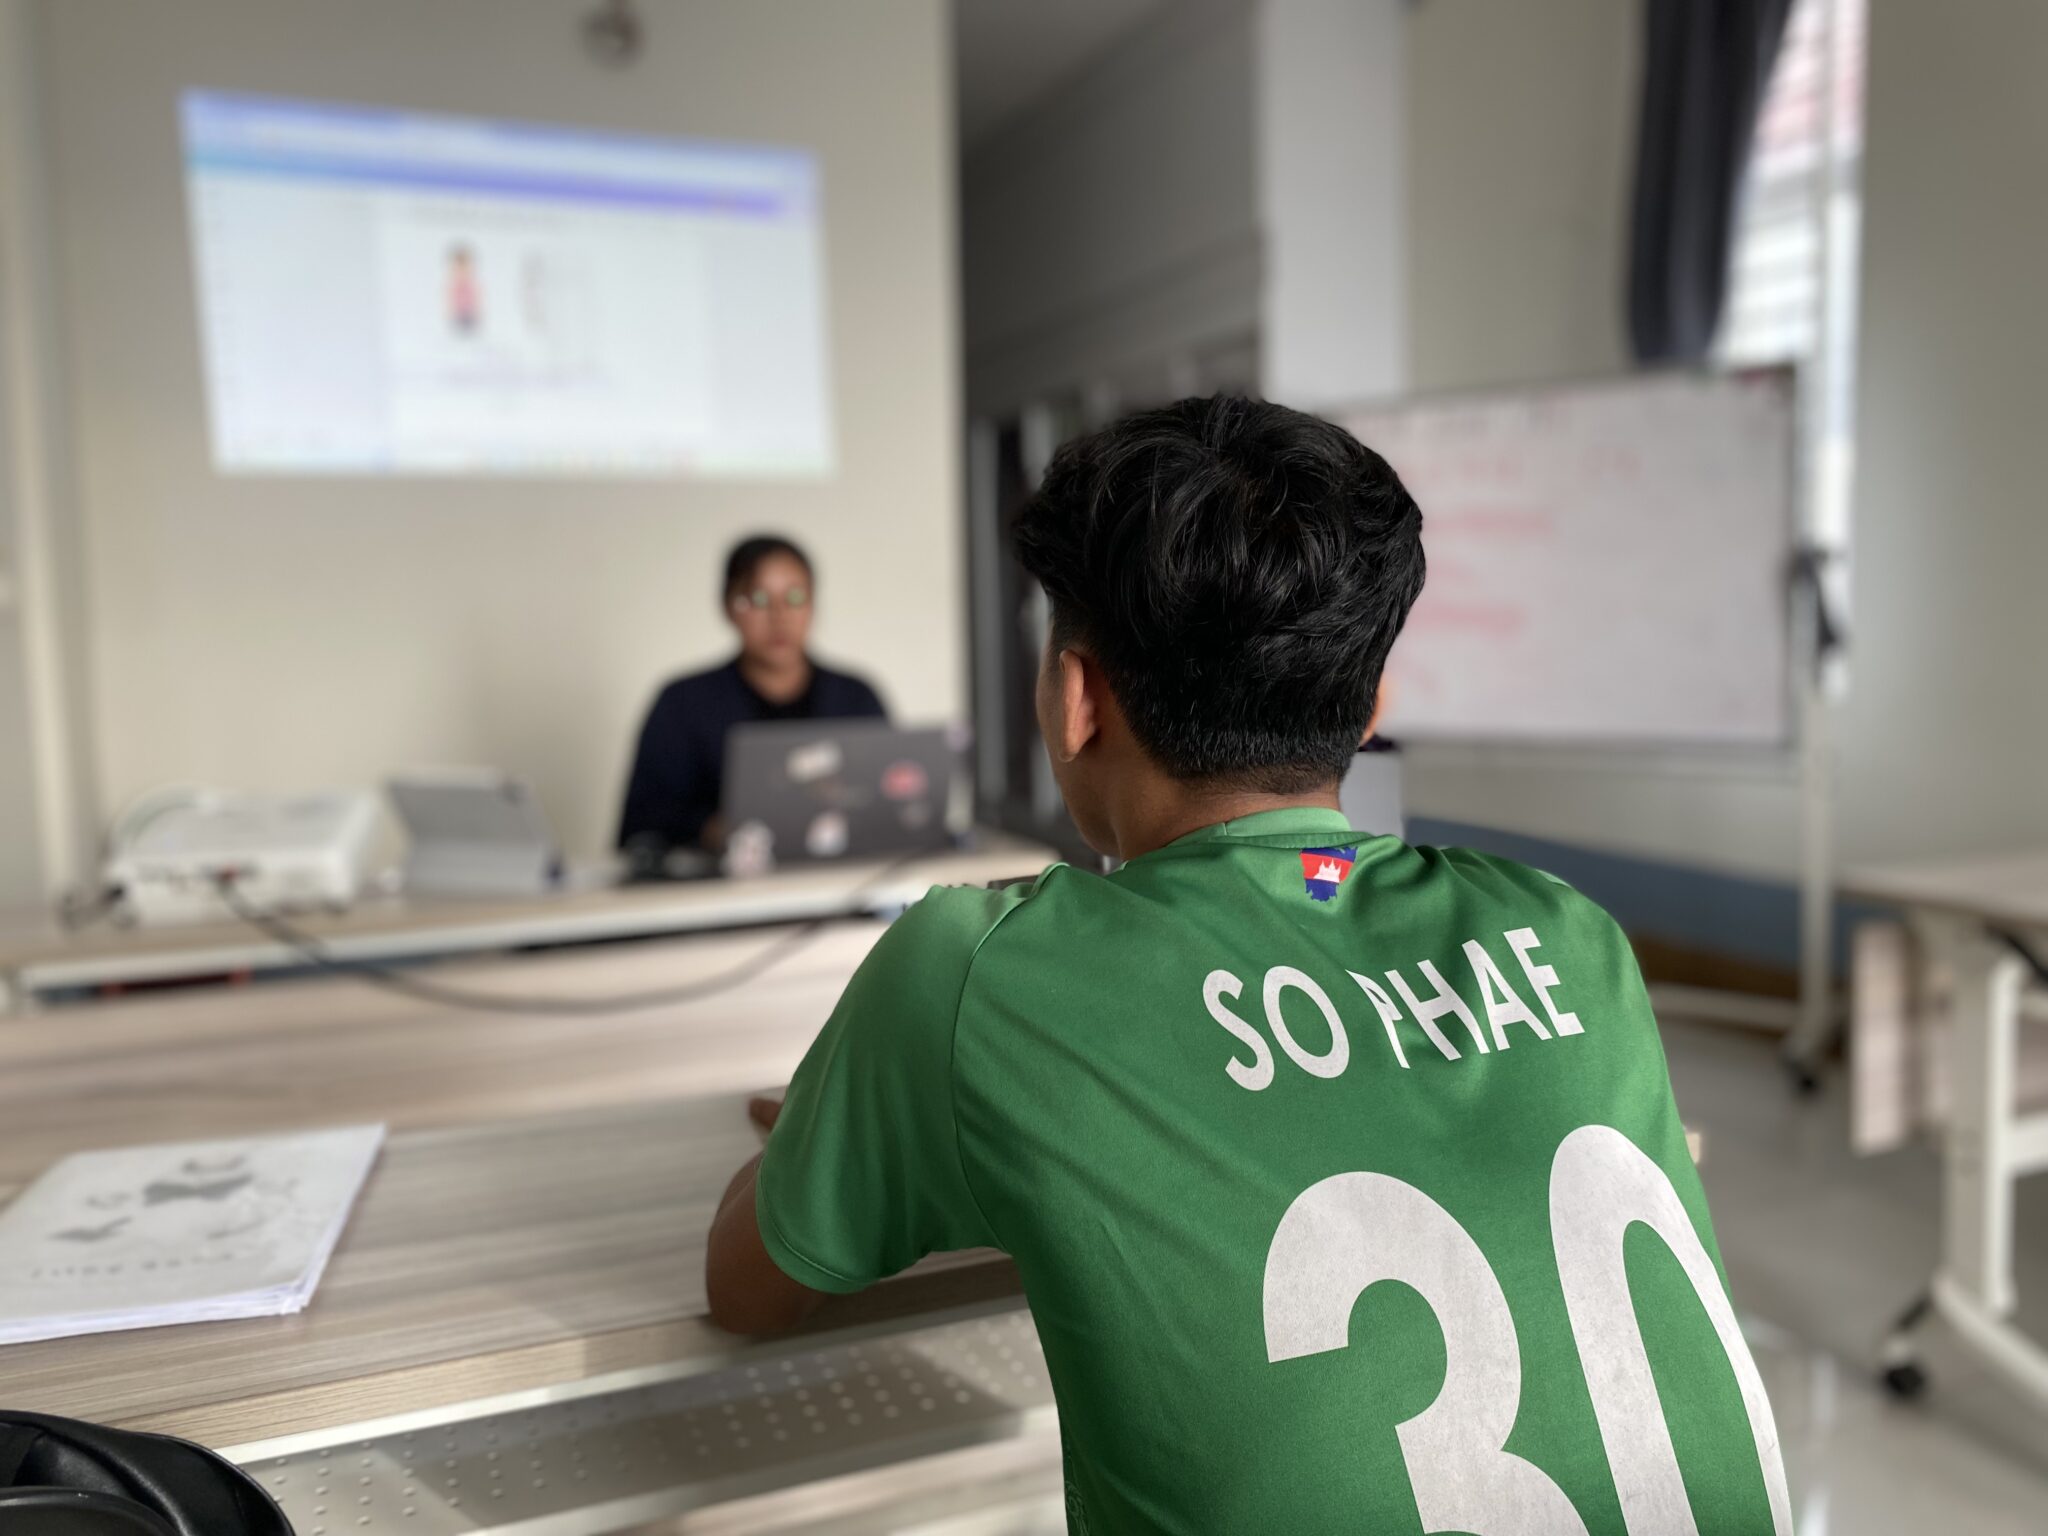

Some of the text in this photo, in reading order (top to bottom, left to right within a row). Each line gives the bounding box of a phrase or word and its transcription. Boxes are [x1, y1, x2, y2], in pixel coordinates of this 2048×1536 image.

[1202, 926, 1586, 1091] SO PHAE
[1262, 1124, 1794, 1536] 30
